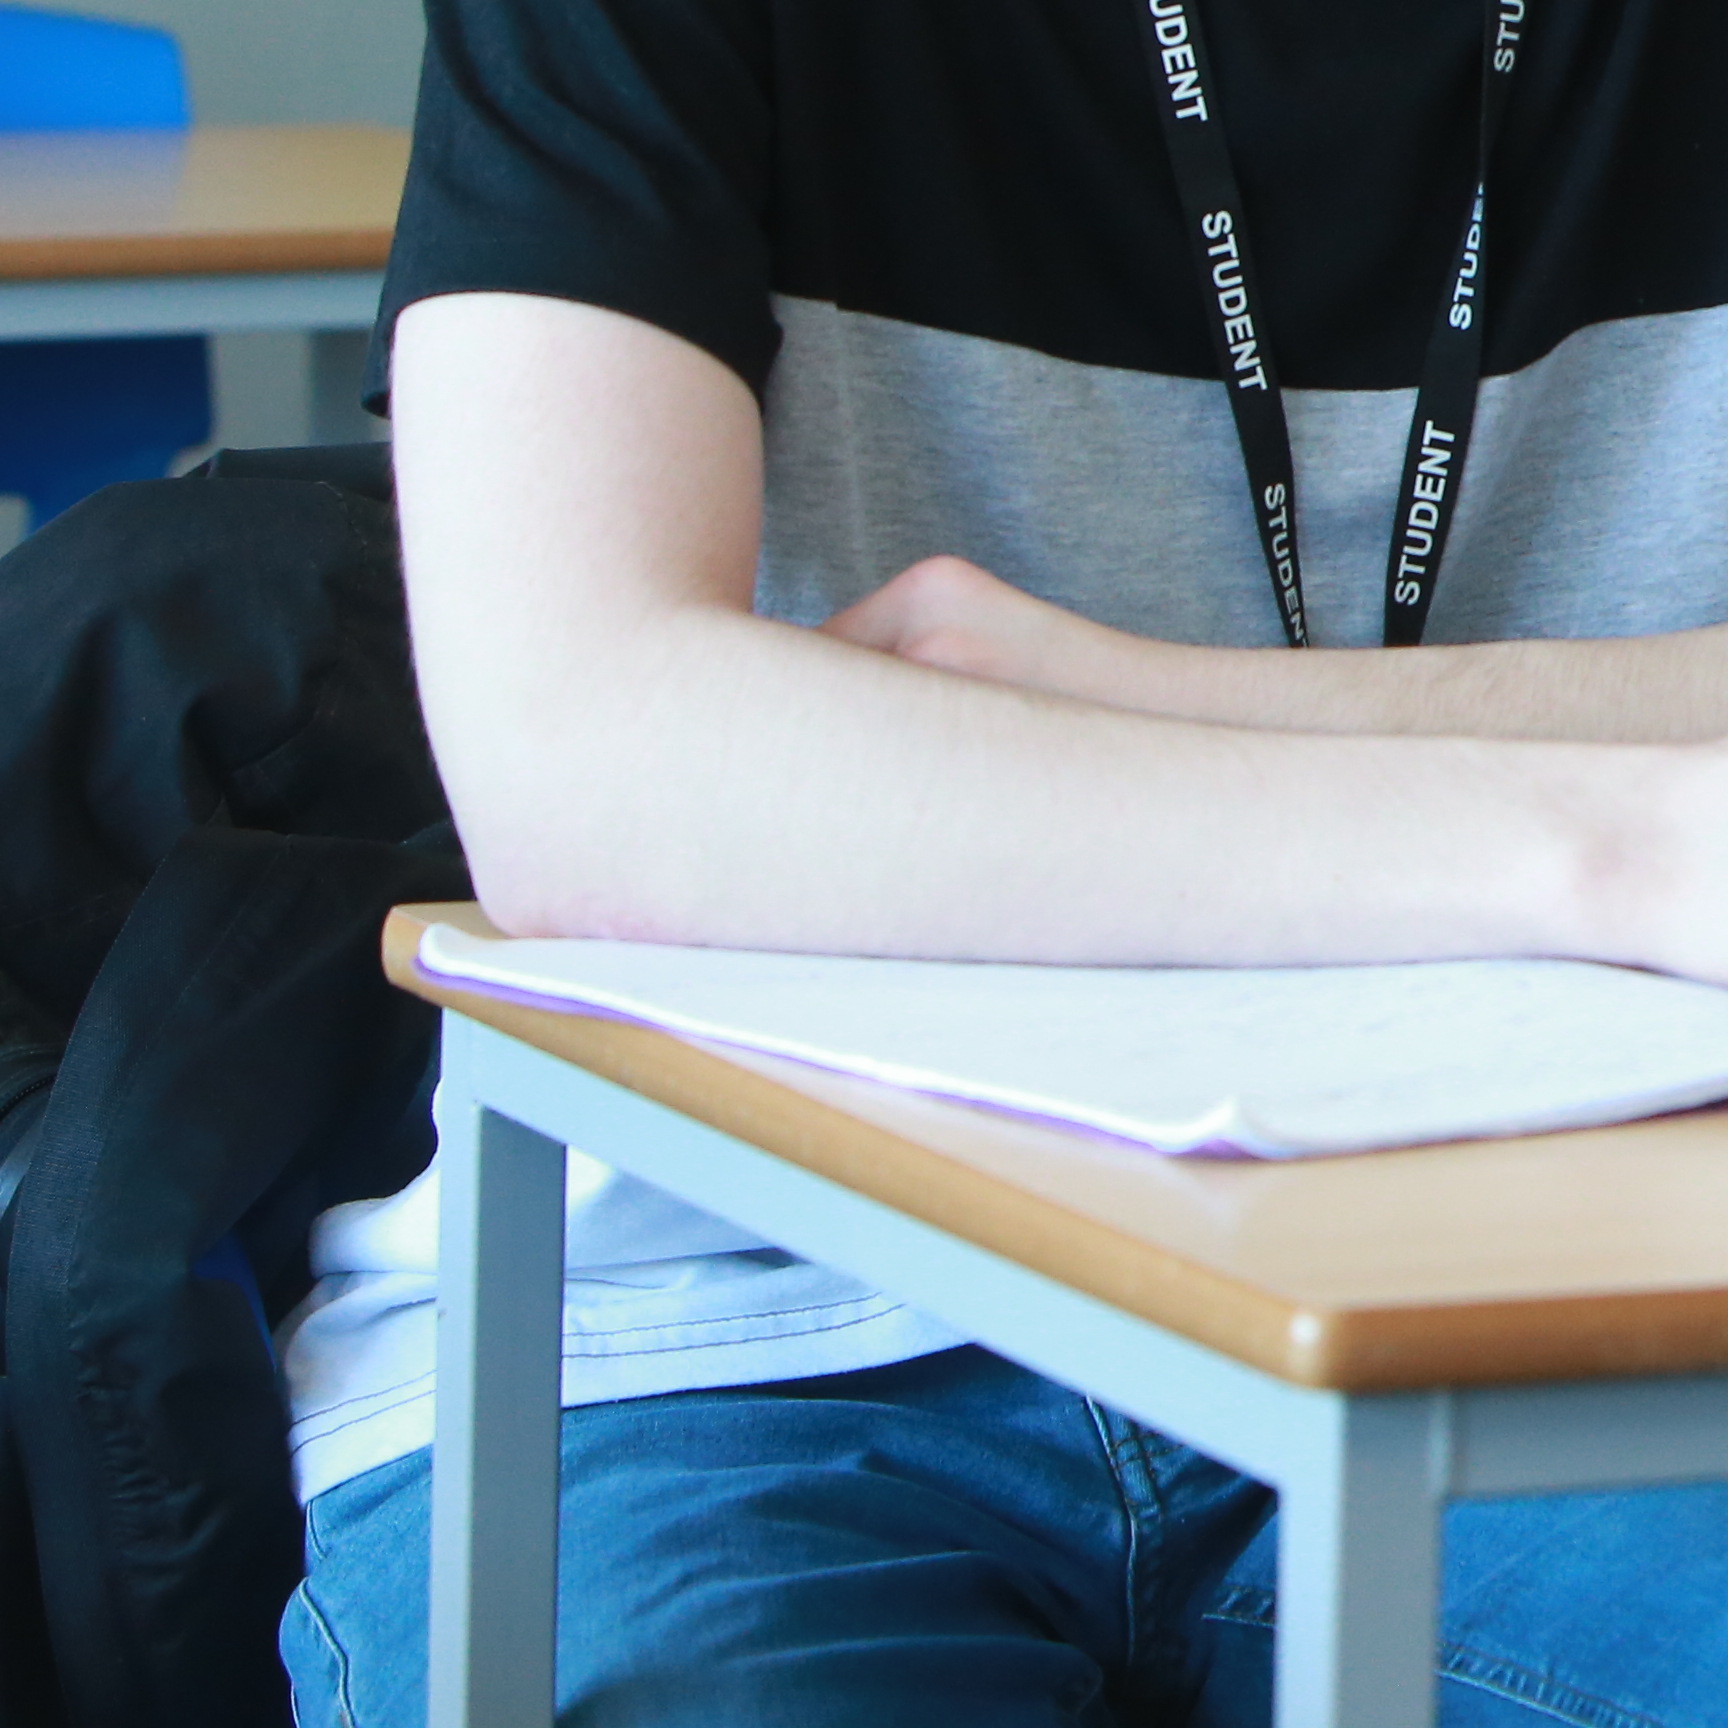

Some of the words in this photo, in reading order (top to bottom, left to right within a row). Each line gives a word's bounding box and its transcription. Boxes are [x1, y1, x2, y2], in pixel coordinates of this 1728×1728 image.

[1201, 209, 1267, 392] STUDENT
[1263, 482, 1309, 648] STUDEN
[1393, 419, 1458, 607] STUDENT
